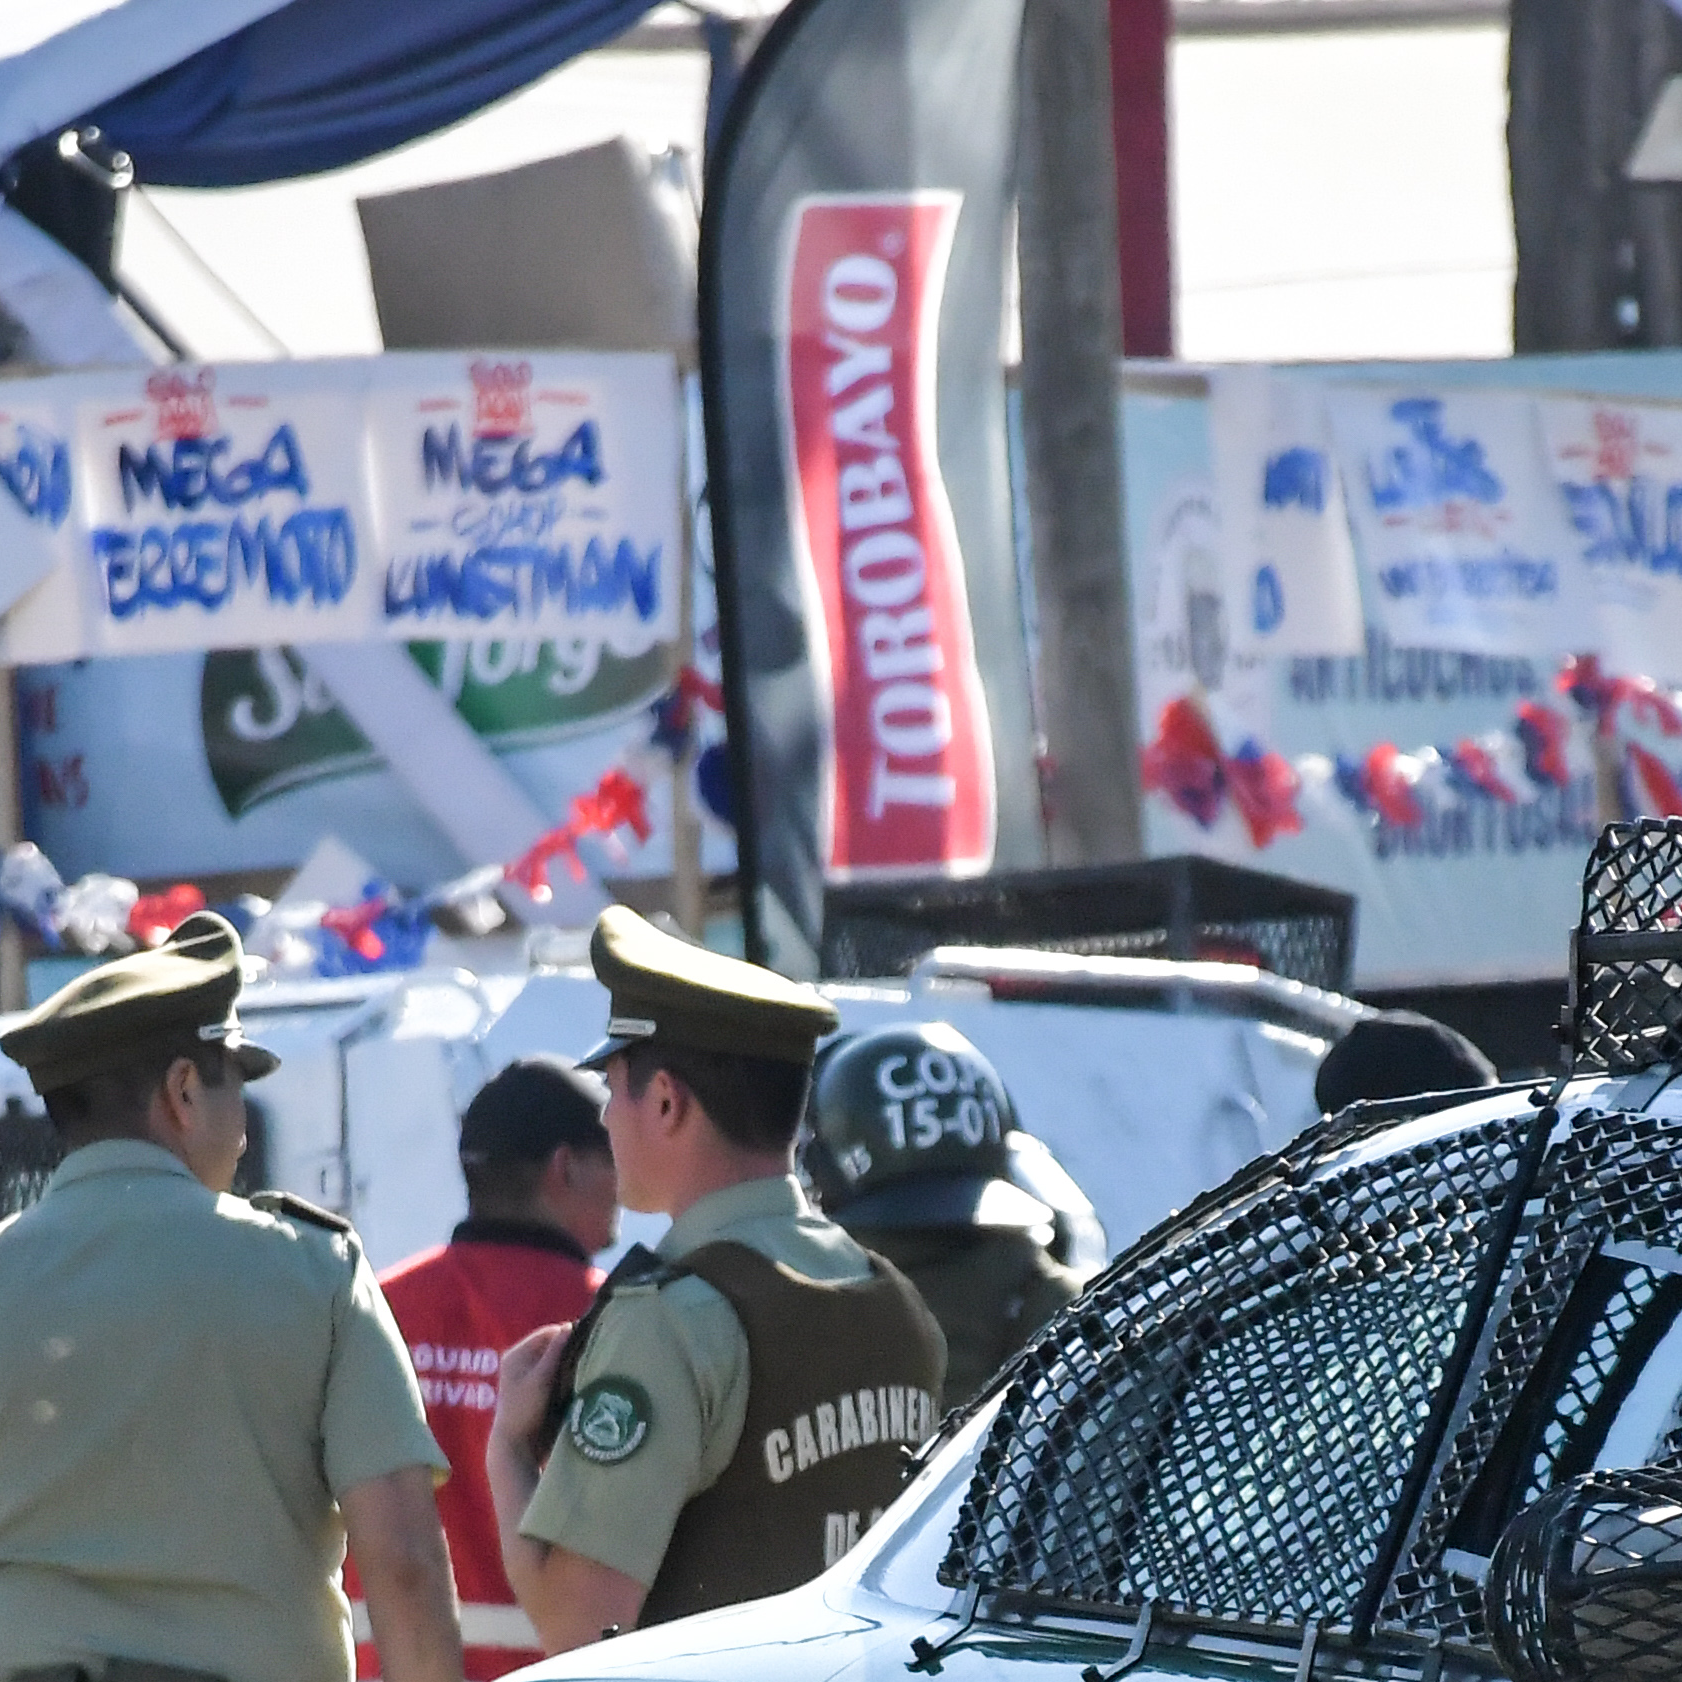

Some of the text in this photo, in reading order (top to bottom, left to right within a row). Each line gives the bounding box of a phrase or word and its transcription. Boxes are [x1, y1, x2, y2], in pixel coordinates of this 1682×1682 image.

[119, 424, 310, 512] MEGA
[422, 420, 604, 494] MEGA
[823, 254, 956, 824] TOROBAYO
[882, 1094, 1002, 1150] 15-01
[412, 1342, 499, 1375] GURID
[419, 1378, 496, 1410] RIVAD
[765, 1386, 942, 1484] CARABINER
